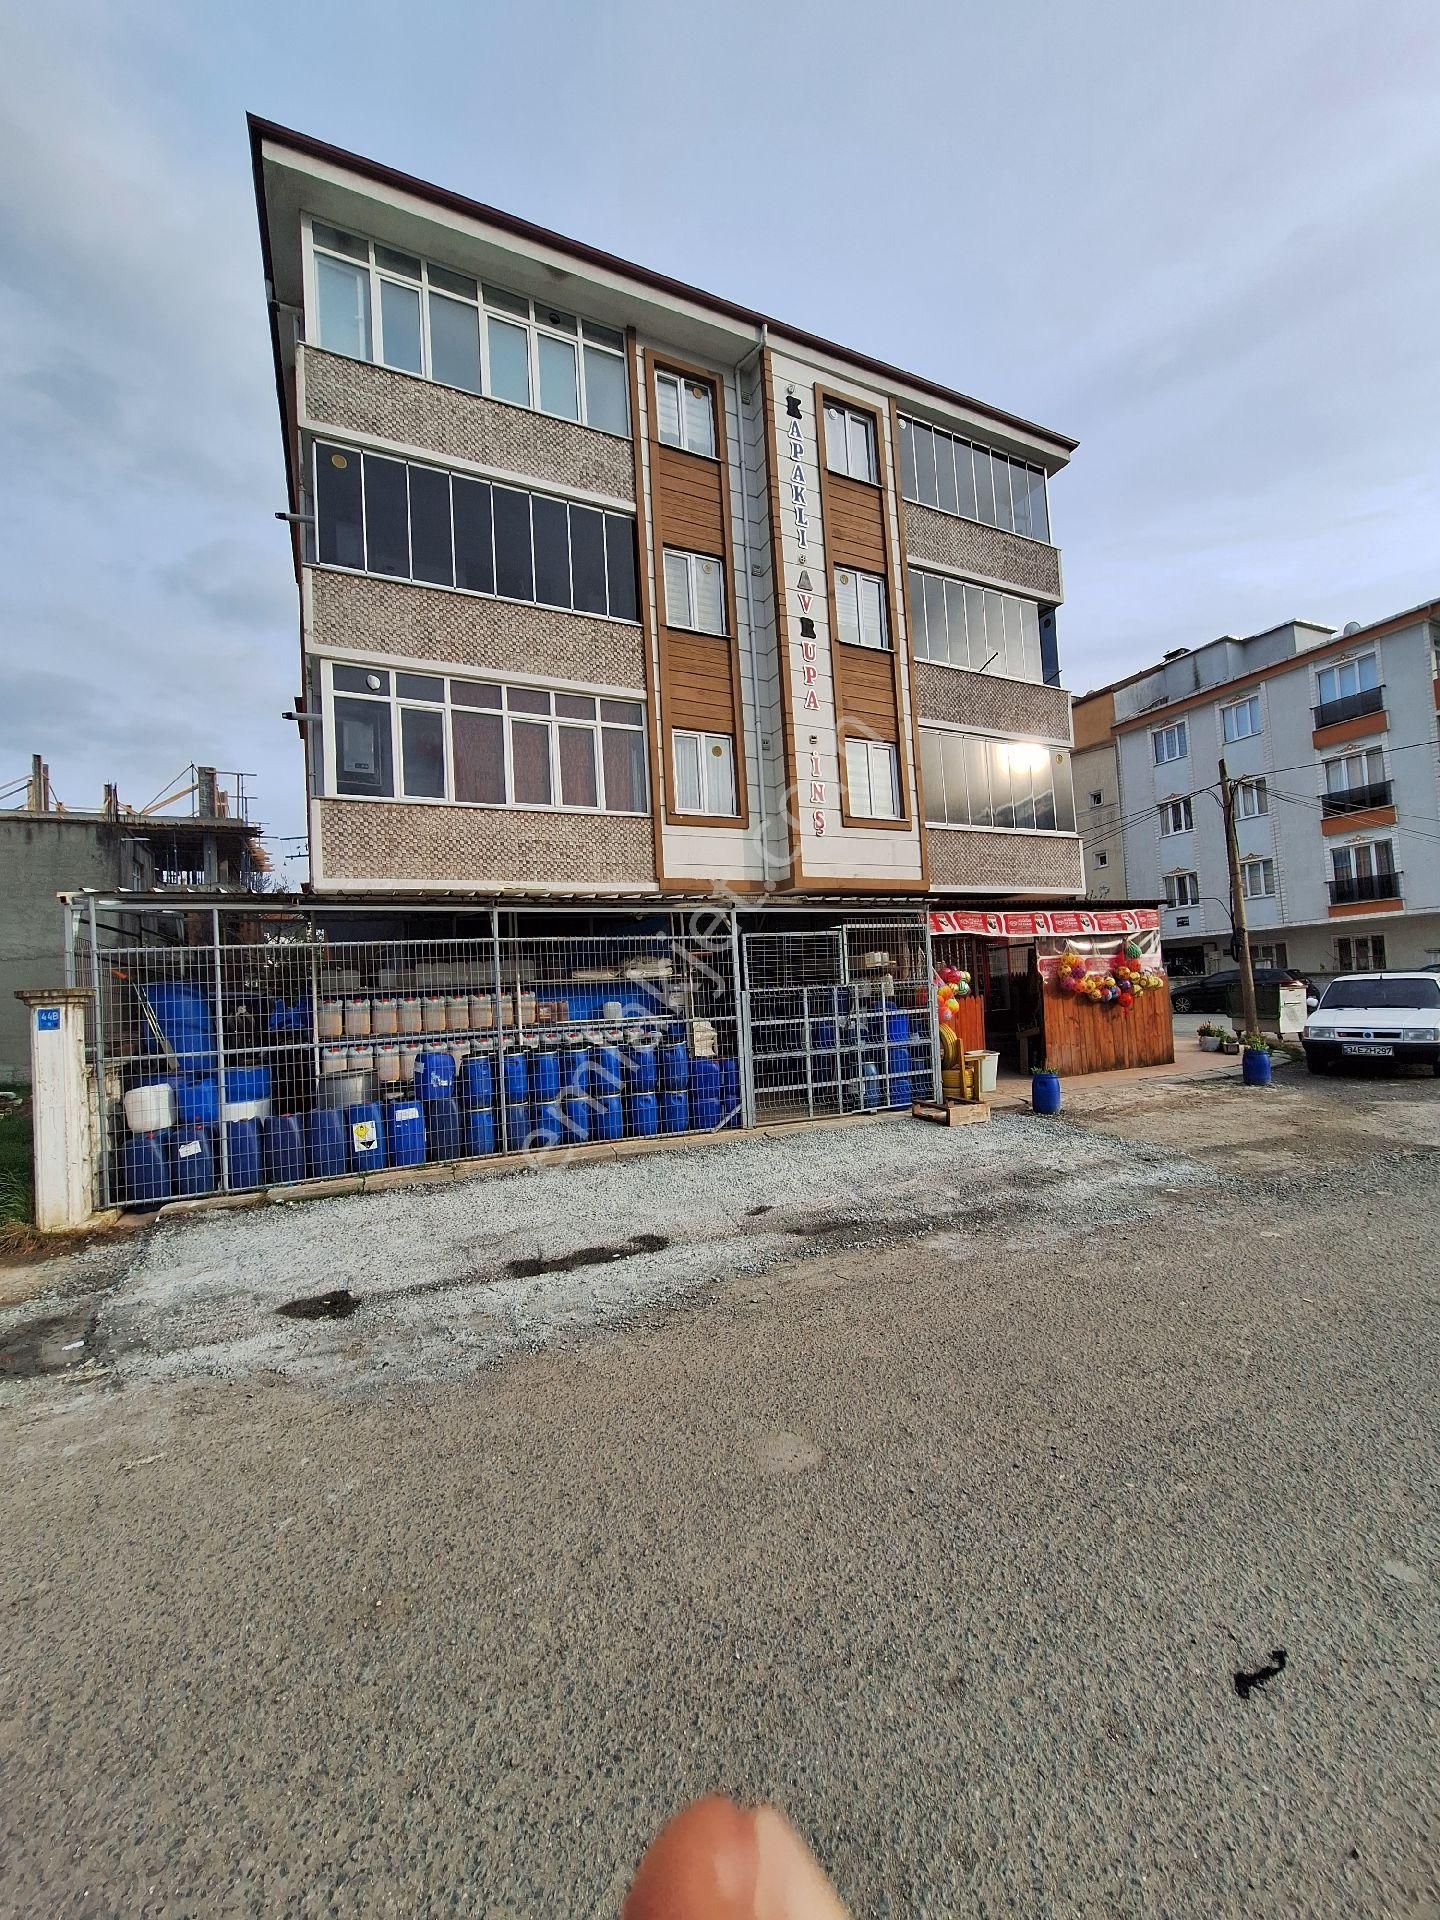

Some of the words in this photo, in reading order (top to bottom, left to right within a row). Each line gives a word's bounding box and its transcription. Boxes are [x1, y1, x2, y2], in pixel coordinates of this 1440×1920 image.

[786, 395, 808, 550] KAPAKLI
[797, 569, 820, 711] AVRUPA
[810, 751, 827, 837] İNŞ
